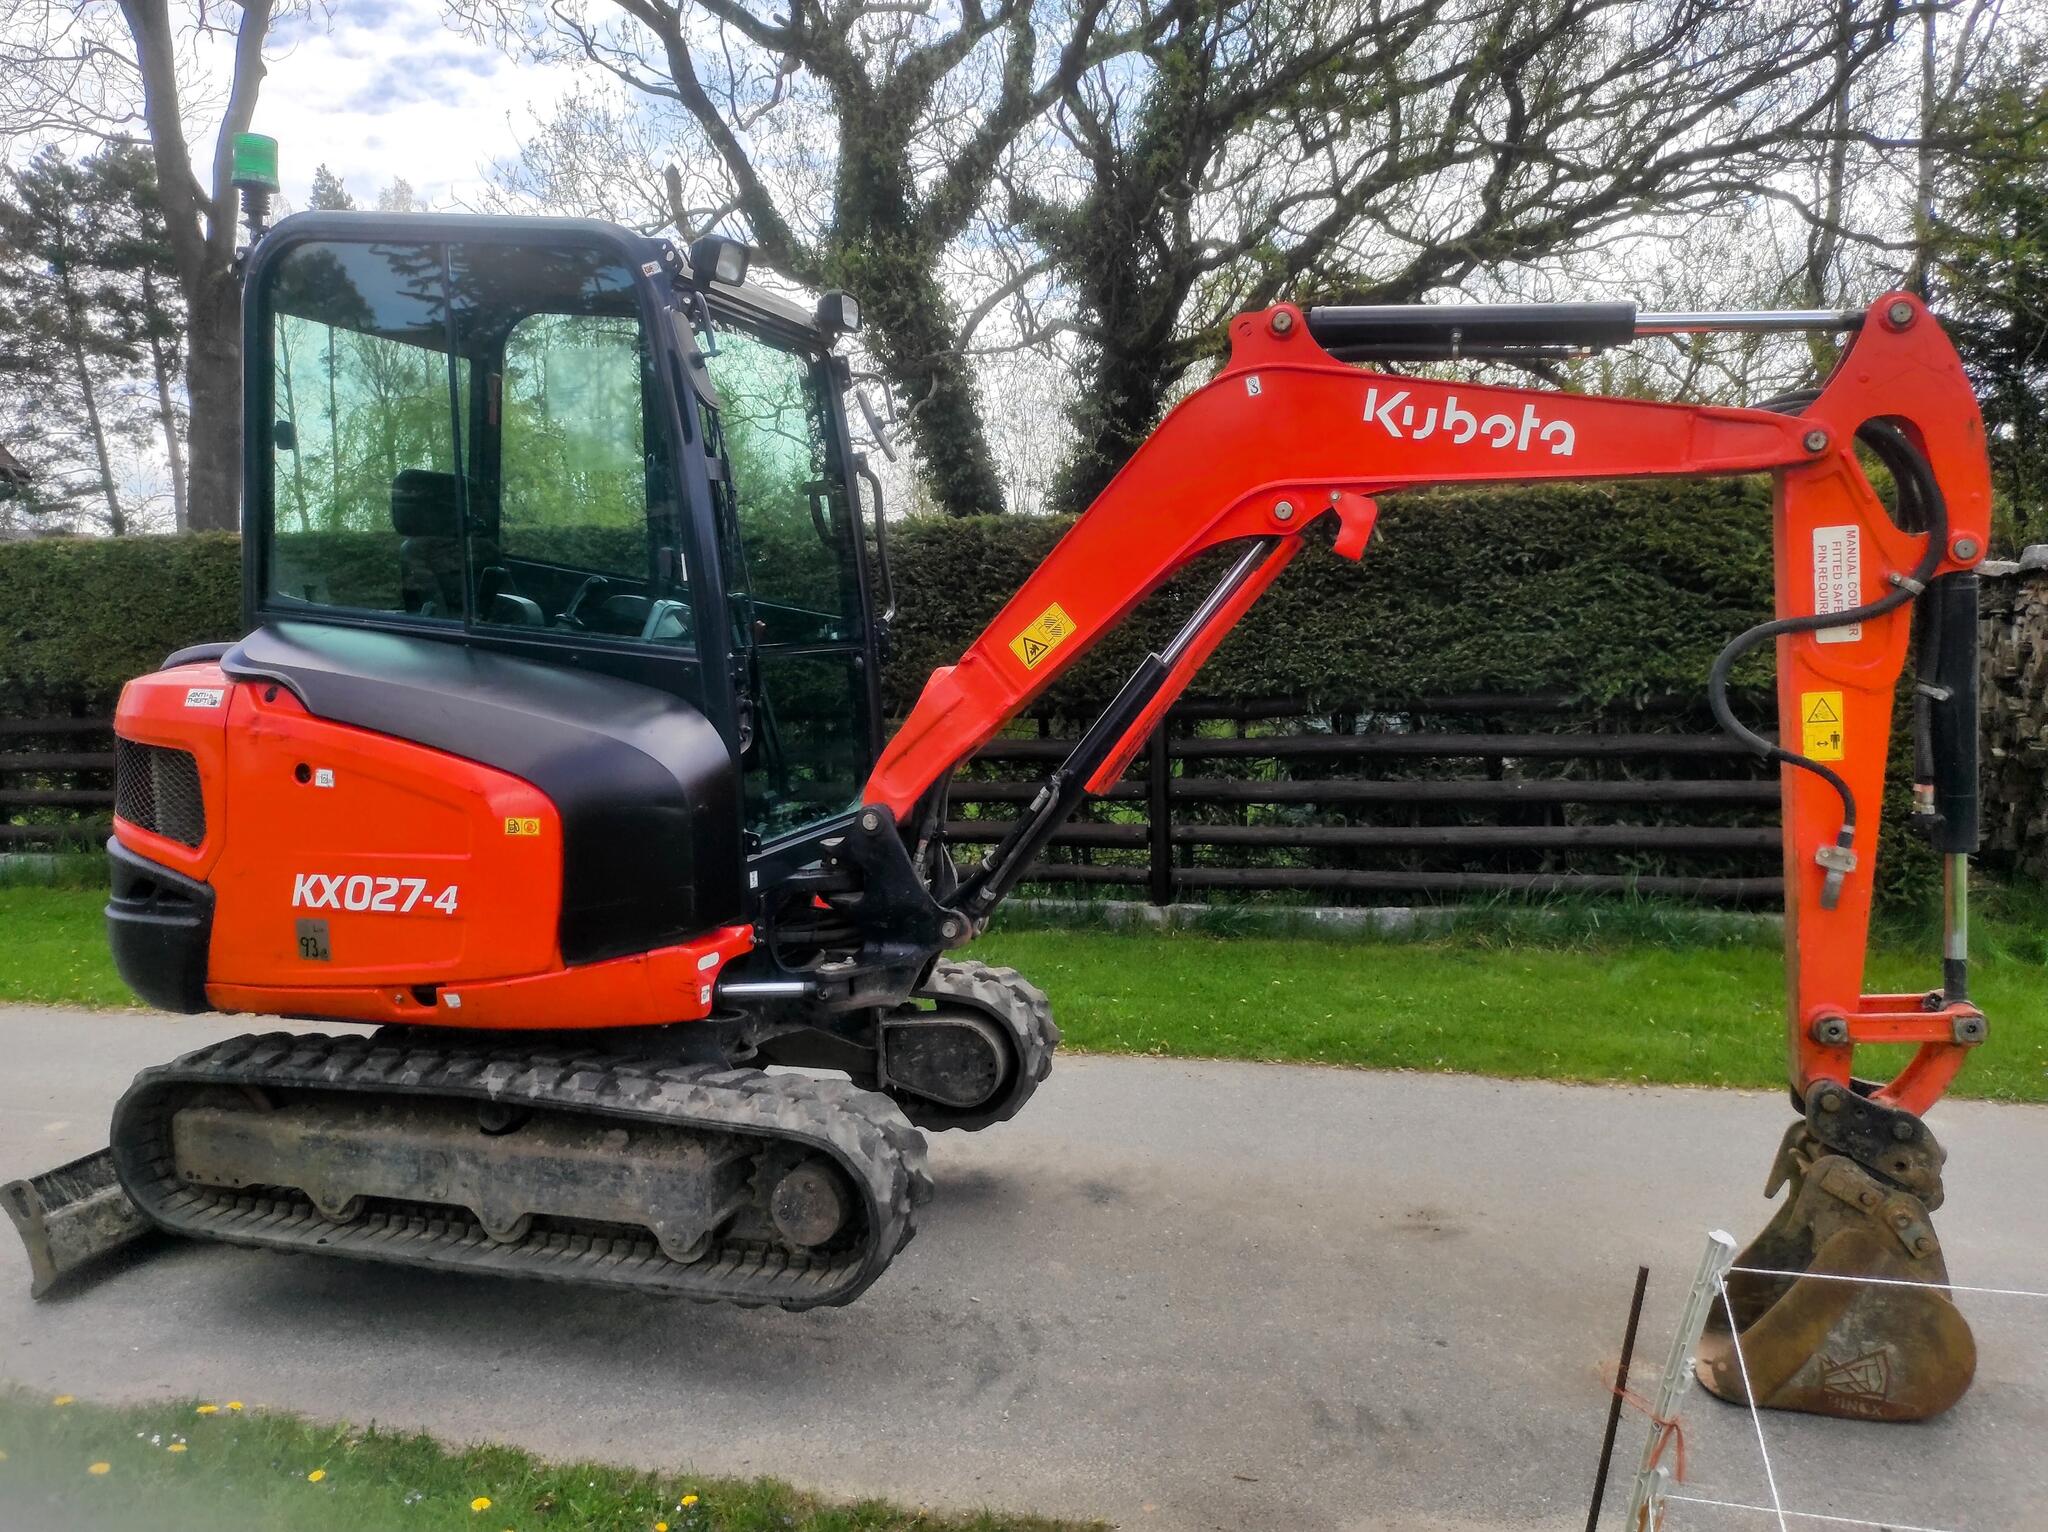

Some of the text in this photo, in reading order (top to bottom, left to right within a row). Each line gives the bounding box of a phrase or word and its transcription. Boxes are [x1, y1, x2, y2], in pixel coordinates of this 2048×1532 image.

[1363, 388, 1576, 456] Kubota
[1818, 545, 1829, 616] PIN REQUIRE
[1831, 541, 1844, 613] FITTED SAFE
[1845, 530, 1859, 636] MANUAL COUER
[292, 873, 458, 914] KX027-4
